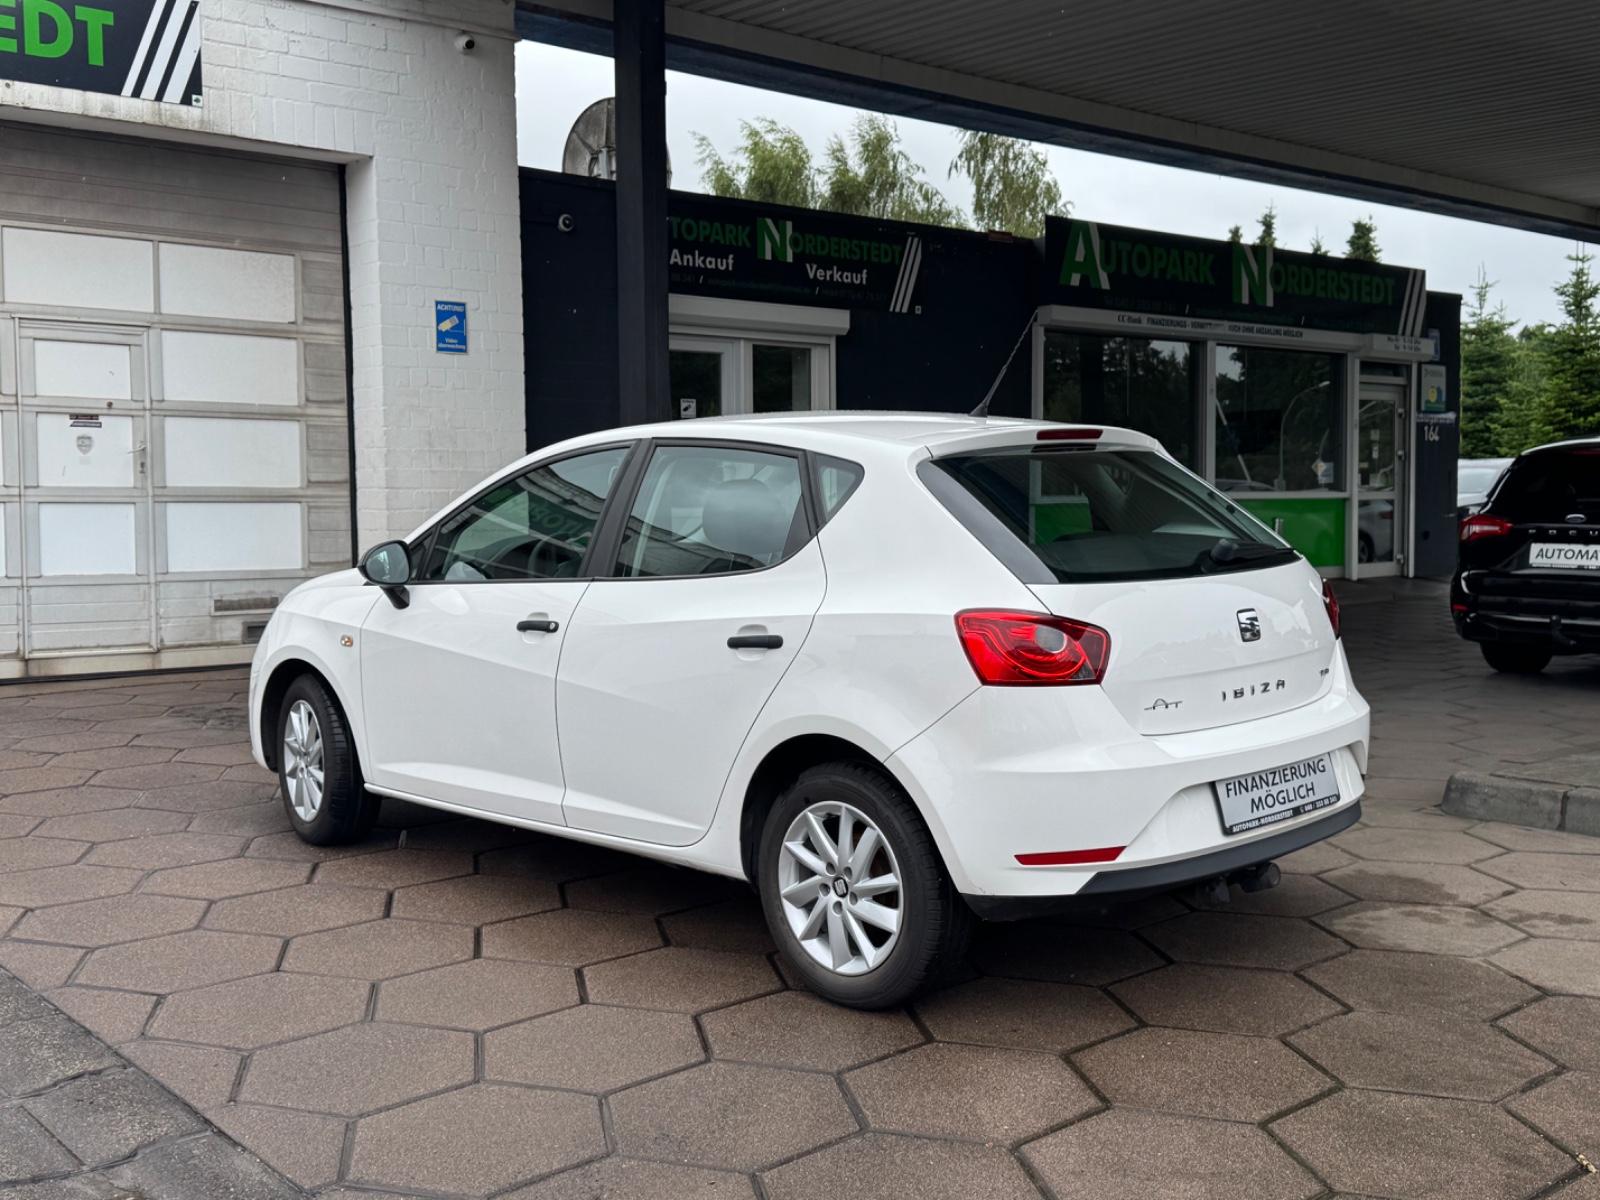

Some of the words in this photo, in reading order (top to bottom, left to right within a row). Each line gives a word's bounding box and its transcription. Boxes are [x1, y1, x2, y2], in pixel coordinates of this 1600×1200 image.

[756, 217, 903, 266] NORDERSTEDT
[669, 248, 735, 271] Ankauf
[1059, 222, 1216, 290] AUTOPARK
[1232, 243, 1396, 308] NORDERSTEDT
[806, 263, 868, 285] Verkauf
[1535, 547, 1600, 561] AUTOMA
[1222, 678, 1286, 702] IBIZA
[1225, 758, 1327, 799] FINANZIERUNG
[1250, 781, 1316, 813] MÖGLICH
